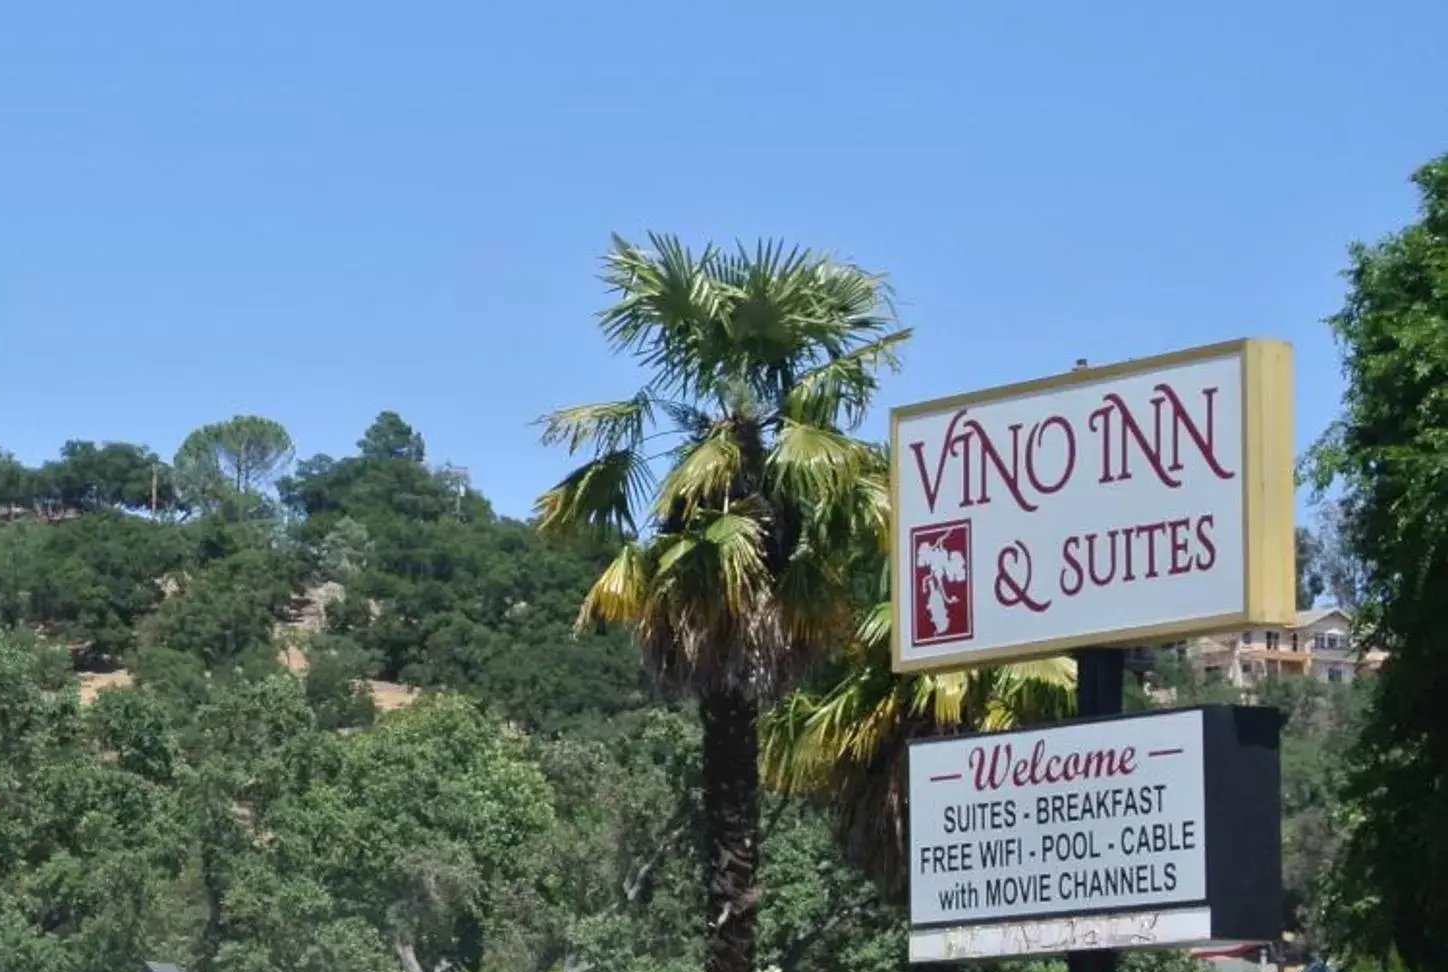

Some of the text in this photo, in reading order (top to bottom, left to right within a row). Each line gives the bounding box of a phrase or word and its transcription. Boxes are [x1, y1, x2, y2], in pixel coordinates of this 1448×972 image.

[909, 382, 1236, 514] VINO INN
[993, 514, 1217, 612] & SUITES
[968, 738, 1137, 792] Welcome
[943, 799, 1017, 834] SUITES
[1036, 784, 1167, 826] BREAKFAST
[919, 842, 973, 875] FREE
[979, 837, 1023, 869] WIFI
[1041, 830, 1101, 863] POOL
[1120, 819, 1196, 856] CABLE
[938, 862, 1178, 912] with MOVIE CHANNELS
